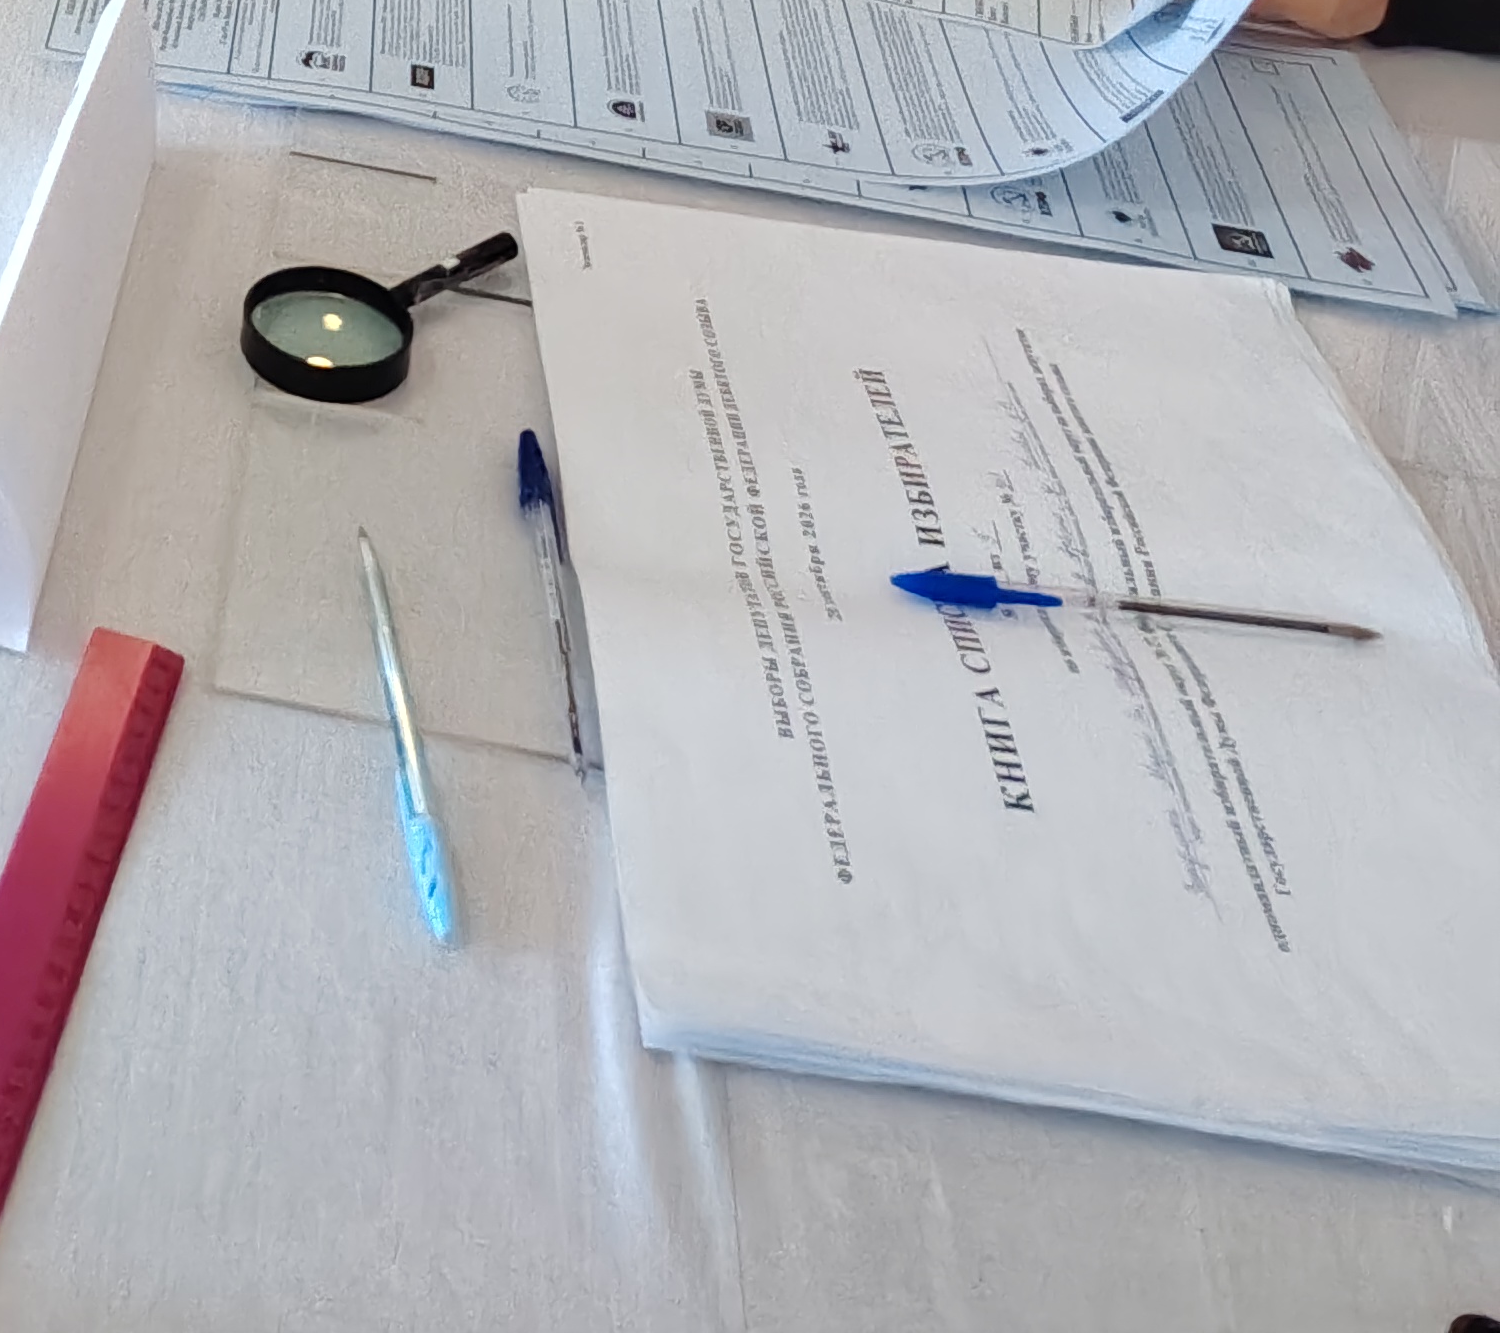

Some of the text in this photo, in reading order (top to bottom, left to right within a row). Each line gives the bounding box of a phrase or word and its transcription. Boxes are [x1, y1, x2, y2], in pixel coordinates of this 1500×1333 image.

[852, 367, 946, 547] ИЗБИРАТЕЛЕЙ
[762, 656, 794, 740] ВЫБОРЫ
[777, 612, 815, 706] СОБРАНИЯ
[803, 711, 853, 884] ФЕДЕРАЛЬНОГО
[974, 686, 1035, 814] КНИГА
